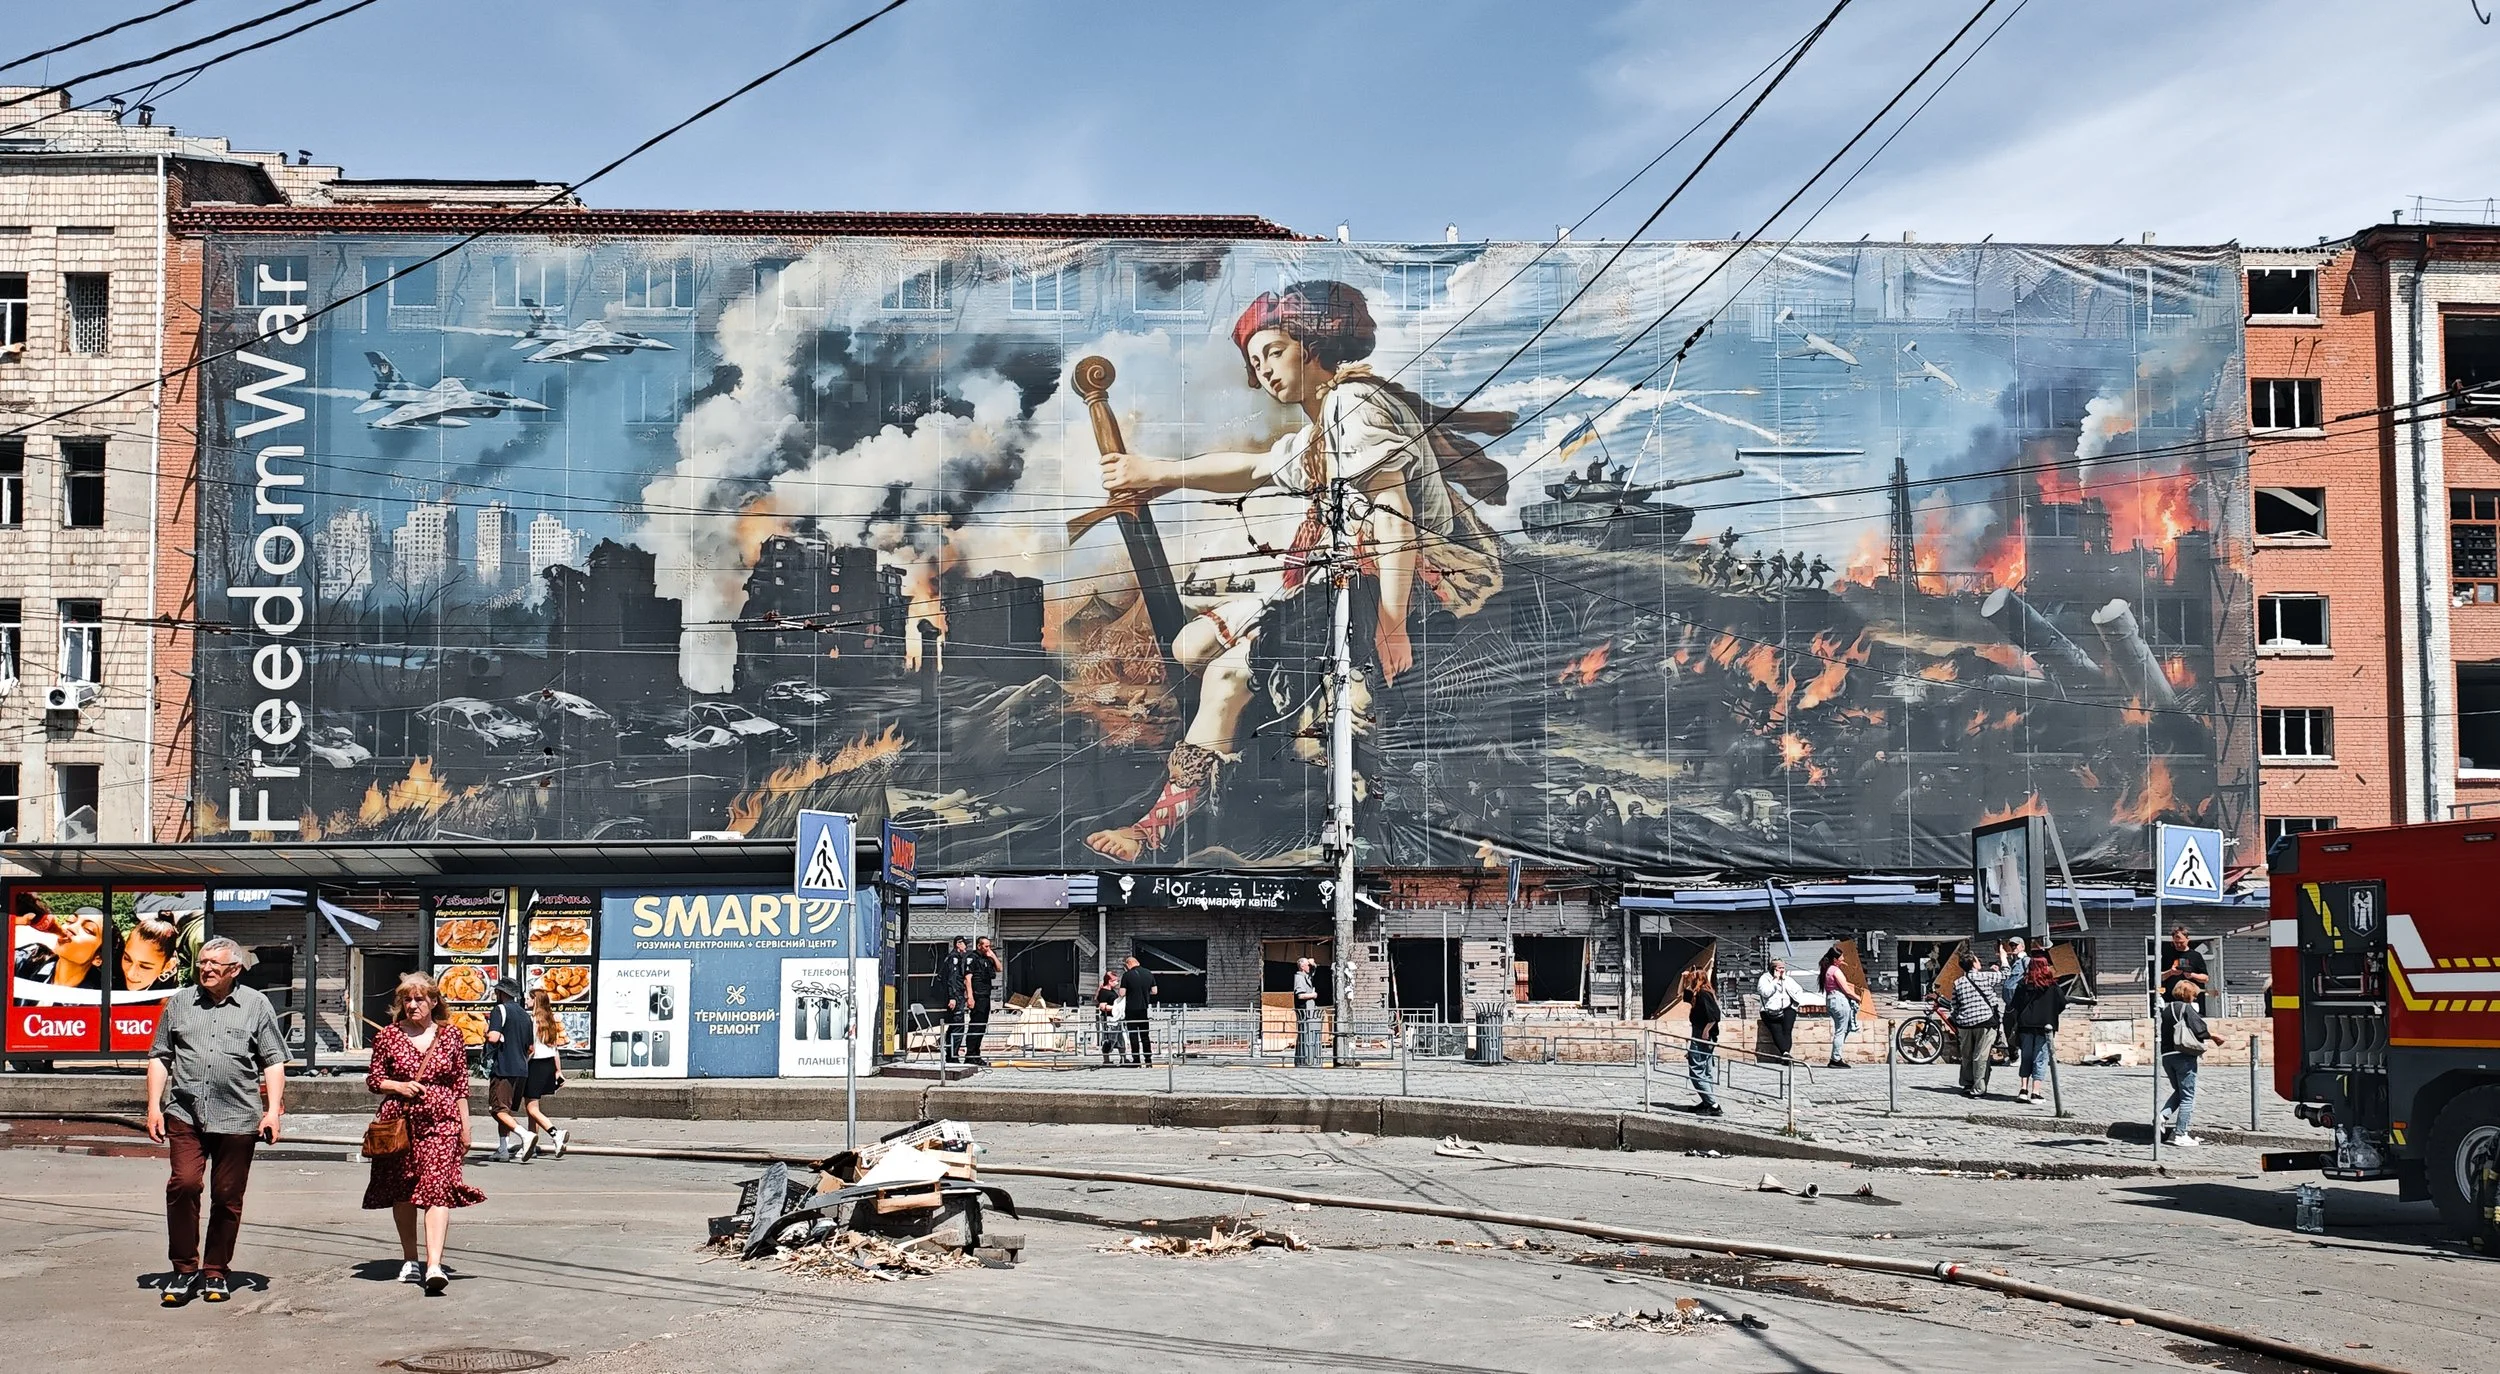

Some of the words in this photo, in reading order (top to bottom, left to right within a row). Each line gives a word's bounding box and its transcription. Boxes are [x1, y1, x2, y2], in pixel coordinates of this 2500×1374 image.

[538, 894, 592, 905] ипічка
[1248, 897, 1278, 908] квітів
[633, 895, 801, 937] SMART
[636, 941, 681, 950] РОЗУМНА
[684, 941, 745, 950] ЕЛЕКТРОНІКА
[755, 939, 806, 949] СЕРВІСНИЙ
[808, 940, 838, 950] ЦЕНТР
[617, 969, 670, 978] АКСЕСУАРИ
[802, 968, 849, 977] ТЕЛЕФОН
[694, 1008, 775, 1022] ТЕРМІНОВИЙ
[23, 1014, 86, 1037] Саме
[115, 1019, 152, 1035] час
[709, 1024, 761, 1035] РЕМОНТ
[798, 1057, 847, 1066] ПЛАНШЕТ
